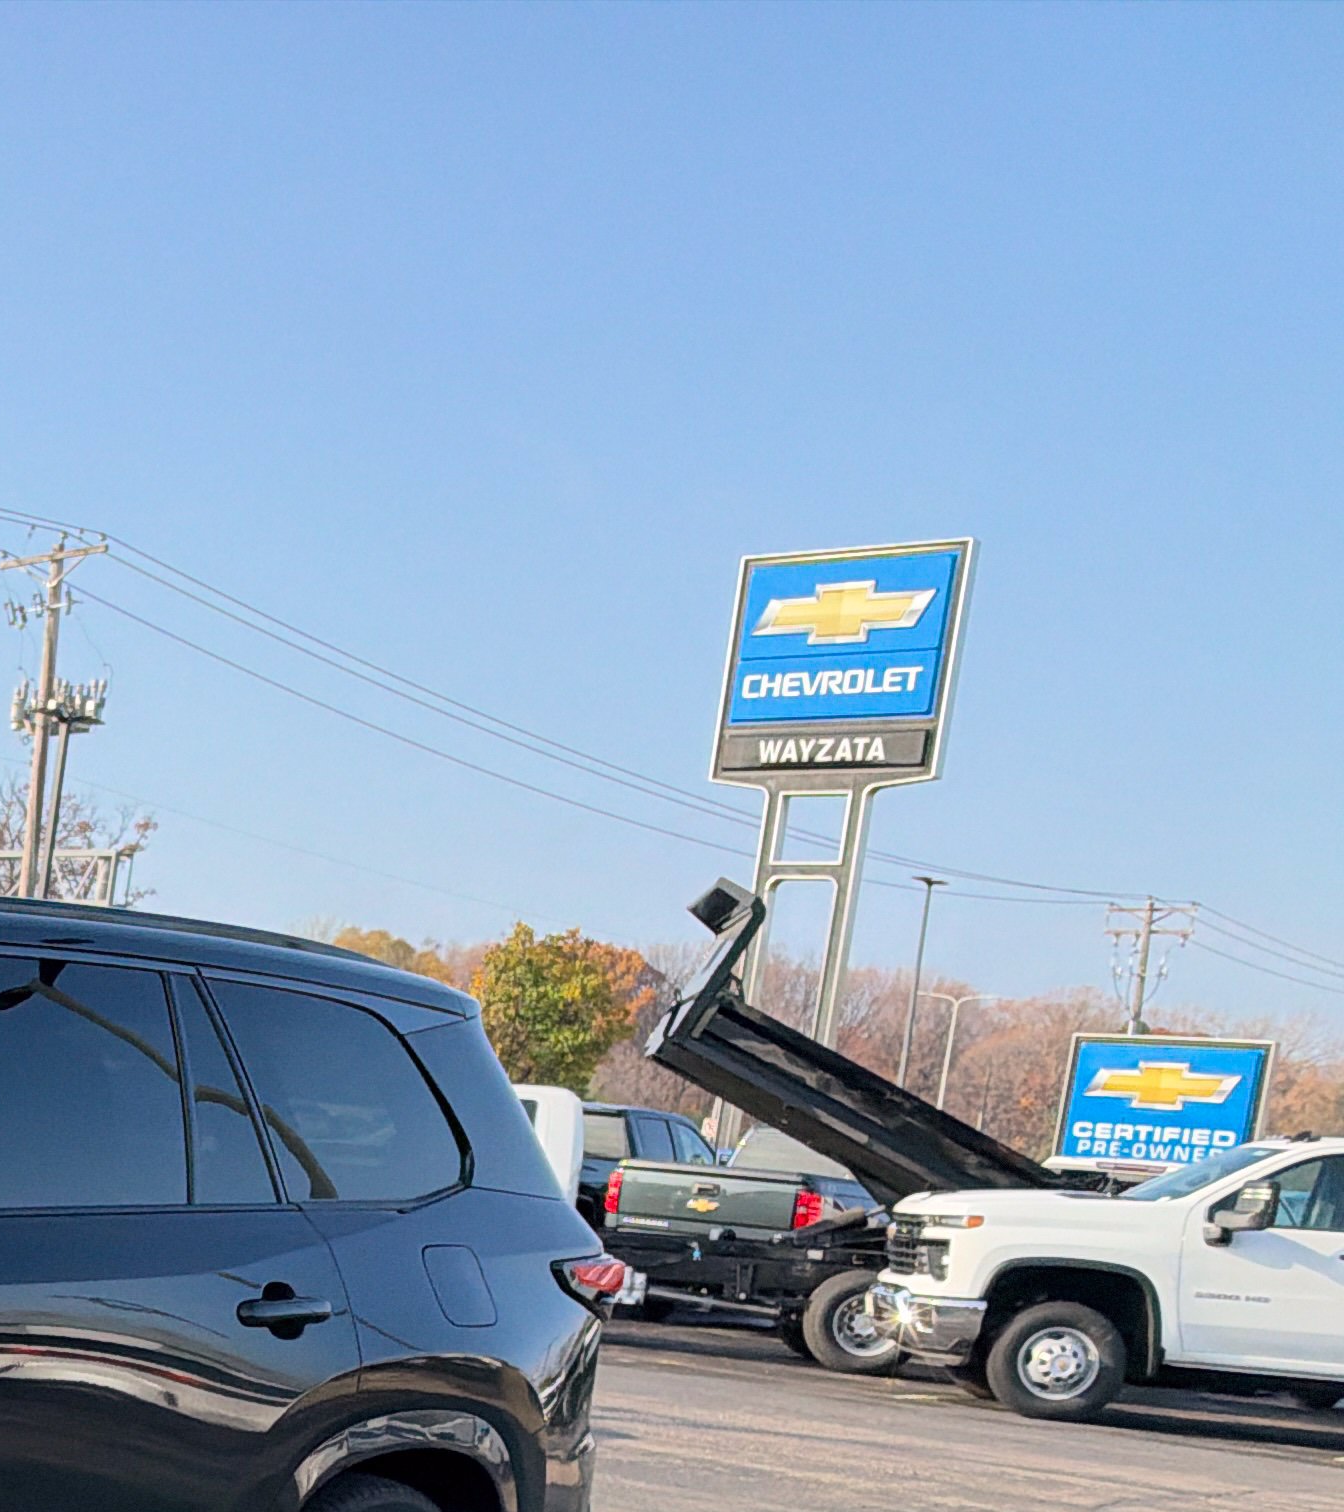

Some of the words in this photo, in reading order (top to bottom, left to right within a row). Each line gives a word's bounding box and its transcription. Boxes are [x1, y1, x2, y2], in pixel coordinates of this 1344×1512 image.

[741, 666, 923, 699] CHEVROLET
[759, 737, 886, 764] WAYZATA
[1072, 1121, 1236, 1147] CERTIFIED
